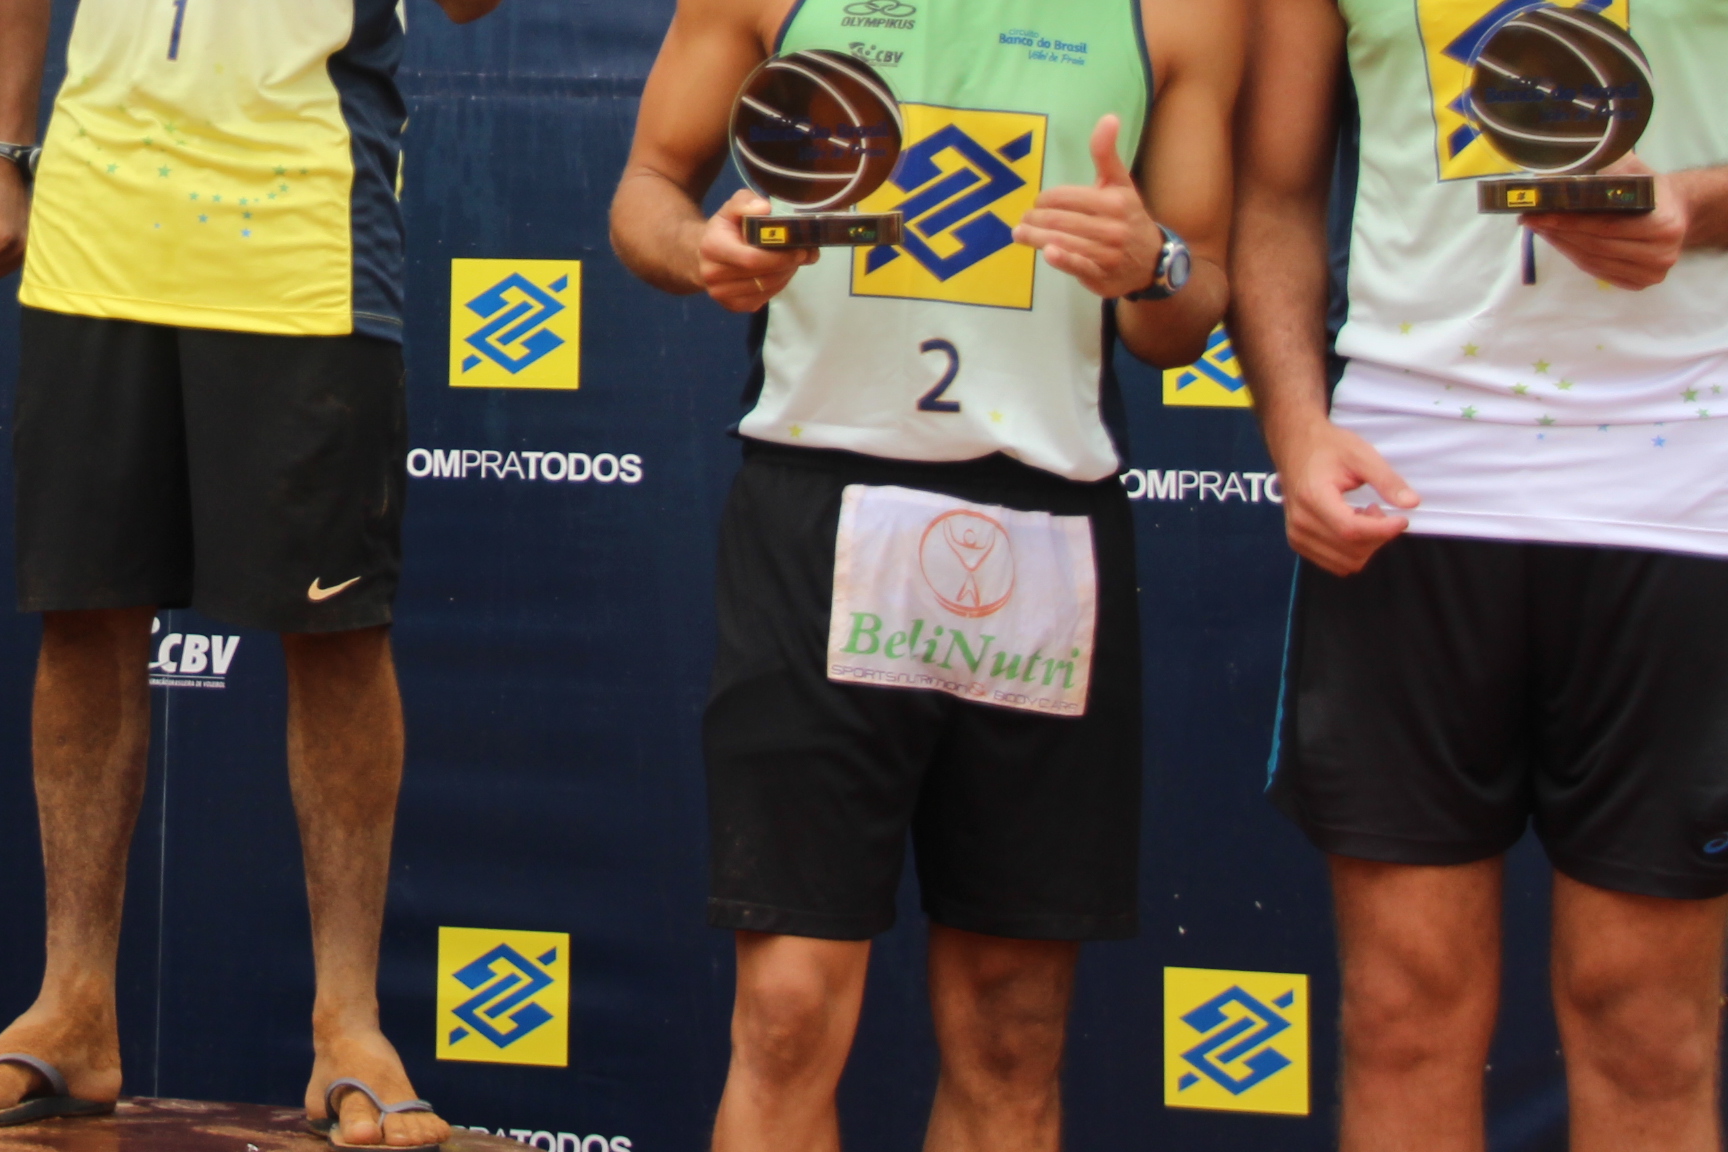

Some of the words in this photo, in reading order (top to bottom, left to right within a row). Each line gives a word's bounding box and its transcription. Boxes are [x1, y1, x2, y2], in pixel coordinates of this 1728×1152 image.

[840, 17, 916, 30] OLYMPIKUS
[1008, 28, 1039, 38] circuito
[875, 50, 904, 64] CBV
[998, 33, 1034, 47] Banco
[1037, 37, 1051, 49] do
[1054, 40, 1088, 54] Brasil
[917, 339, 961, 414] 2
[407, 448, 642, 483] OMPRATODOS
[158, 633, 241, 674] CBV
[839, 612, 1081, 690] BeliNutri
